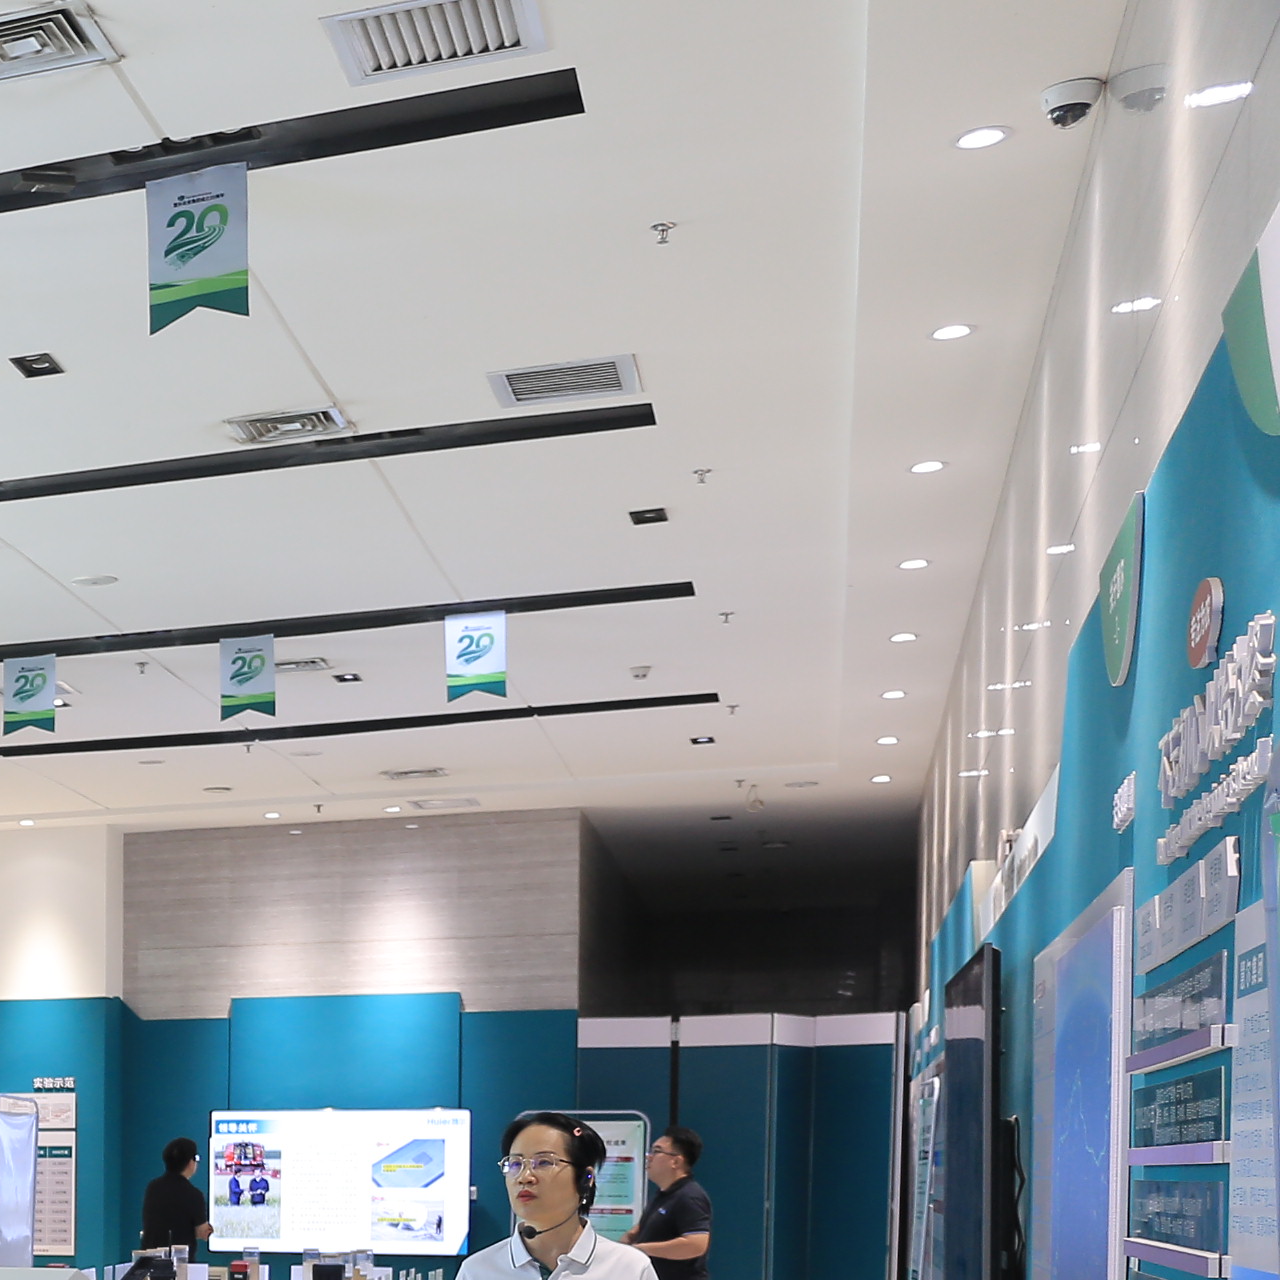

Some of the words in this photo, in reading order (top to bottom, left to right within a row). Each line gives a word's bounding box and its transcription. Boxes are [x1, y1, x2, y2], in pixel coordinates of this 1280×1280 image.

[164, 203, 229, 260] 20
[457, 632, 495, 662] 20
[230, 653, 266, 684] 20
[12, 672, 47, 702] 20
[33, 1077, 75, 1089] 实验示范
